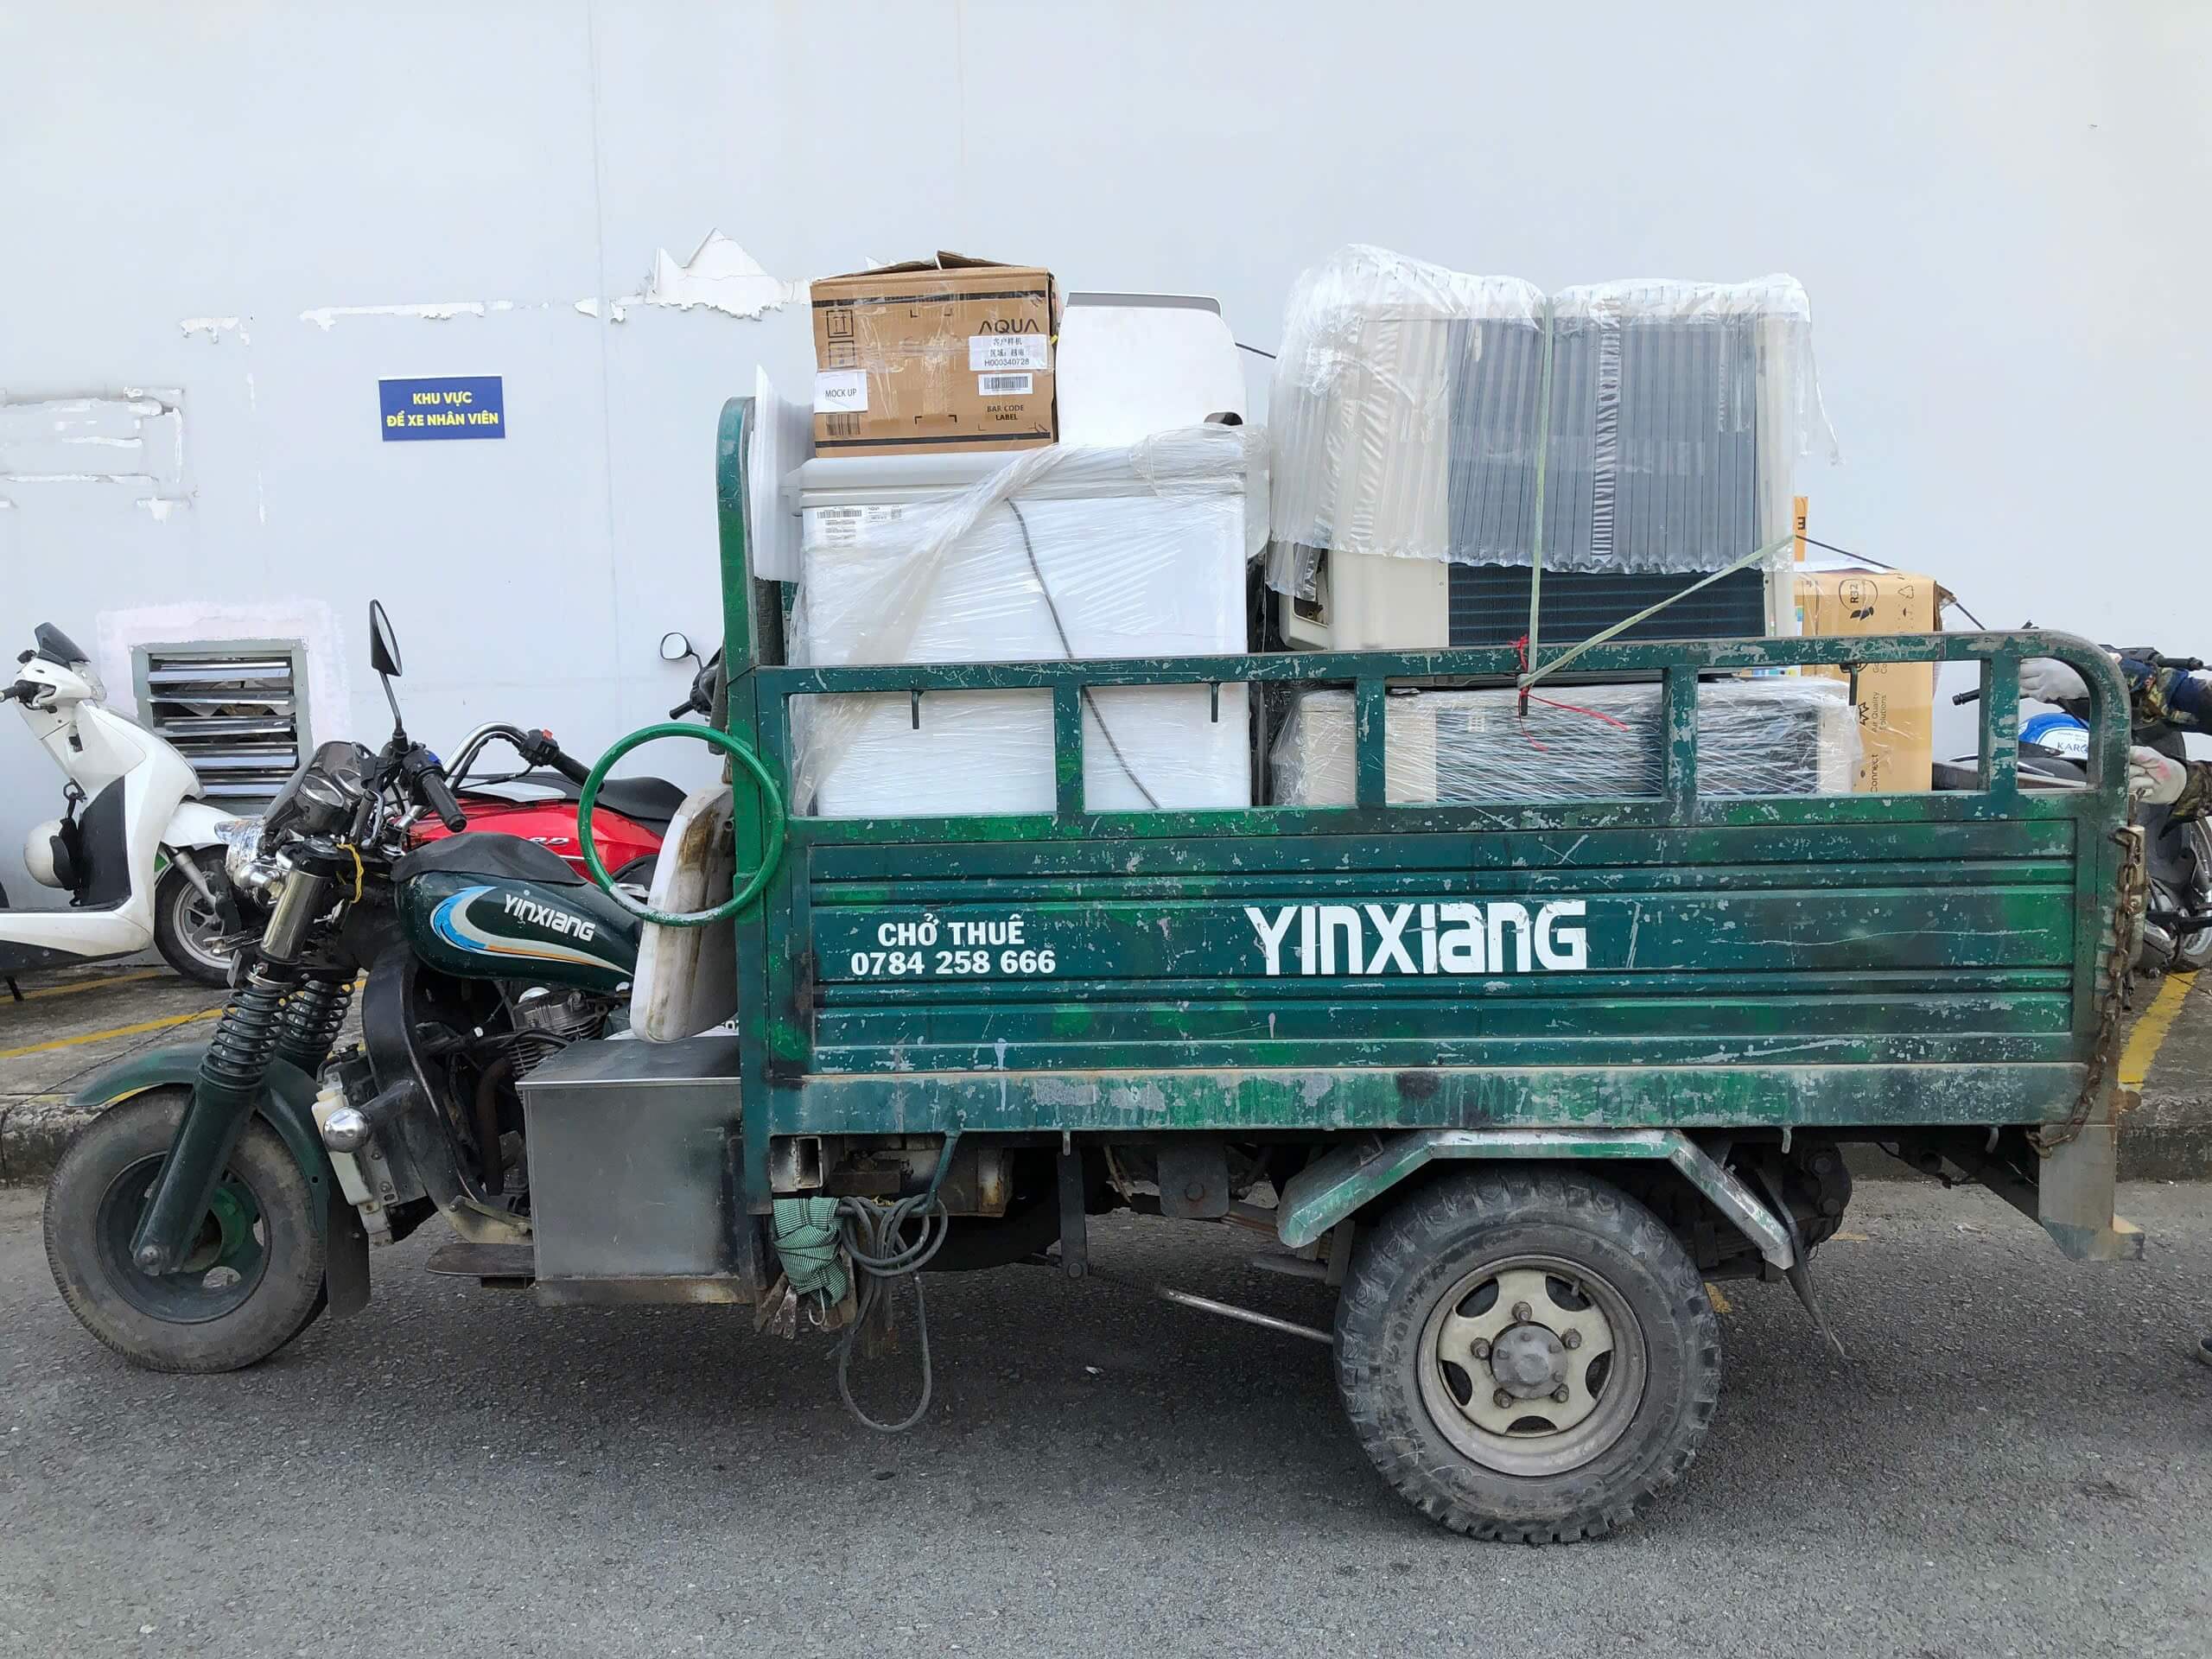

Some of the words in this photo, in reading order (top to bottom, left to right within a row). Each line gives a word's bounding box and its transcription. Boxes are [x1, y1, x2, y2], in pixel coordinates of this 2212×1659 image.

[978, 319, 1039, 334] AQUA
[413, 392, 441, 405] KHU
[443, 391, 473, 406] VỰC
[825, 389, 846, 397] MOCK
[847, 388, 857, 397] UP
[386, 410, 405, 427] ĐỂ
[407, 414, 424, 427] XE
[427, 410, 465, 426] NHÂN
[467, 410, 499, 424] VIÊN
[1849, 583, 1859, 604] R32
[1872, 691, 1880, 718] Quality
[1878, 695, 1887, 730] Solutions
[1870, 753, 1879, 793] Connect
[877, 913, 940, 947] CHỞ
[947, 913, 1025, 946] THUÊ
[850, 951, 925, 976] 0784
[935, 950, 974, 975] 258
[1000, 950, 1057, 974] 666
